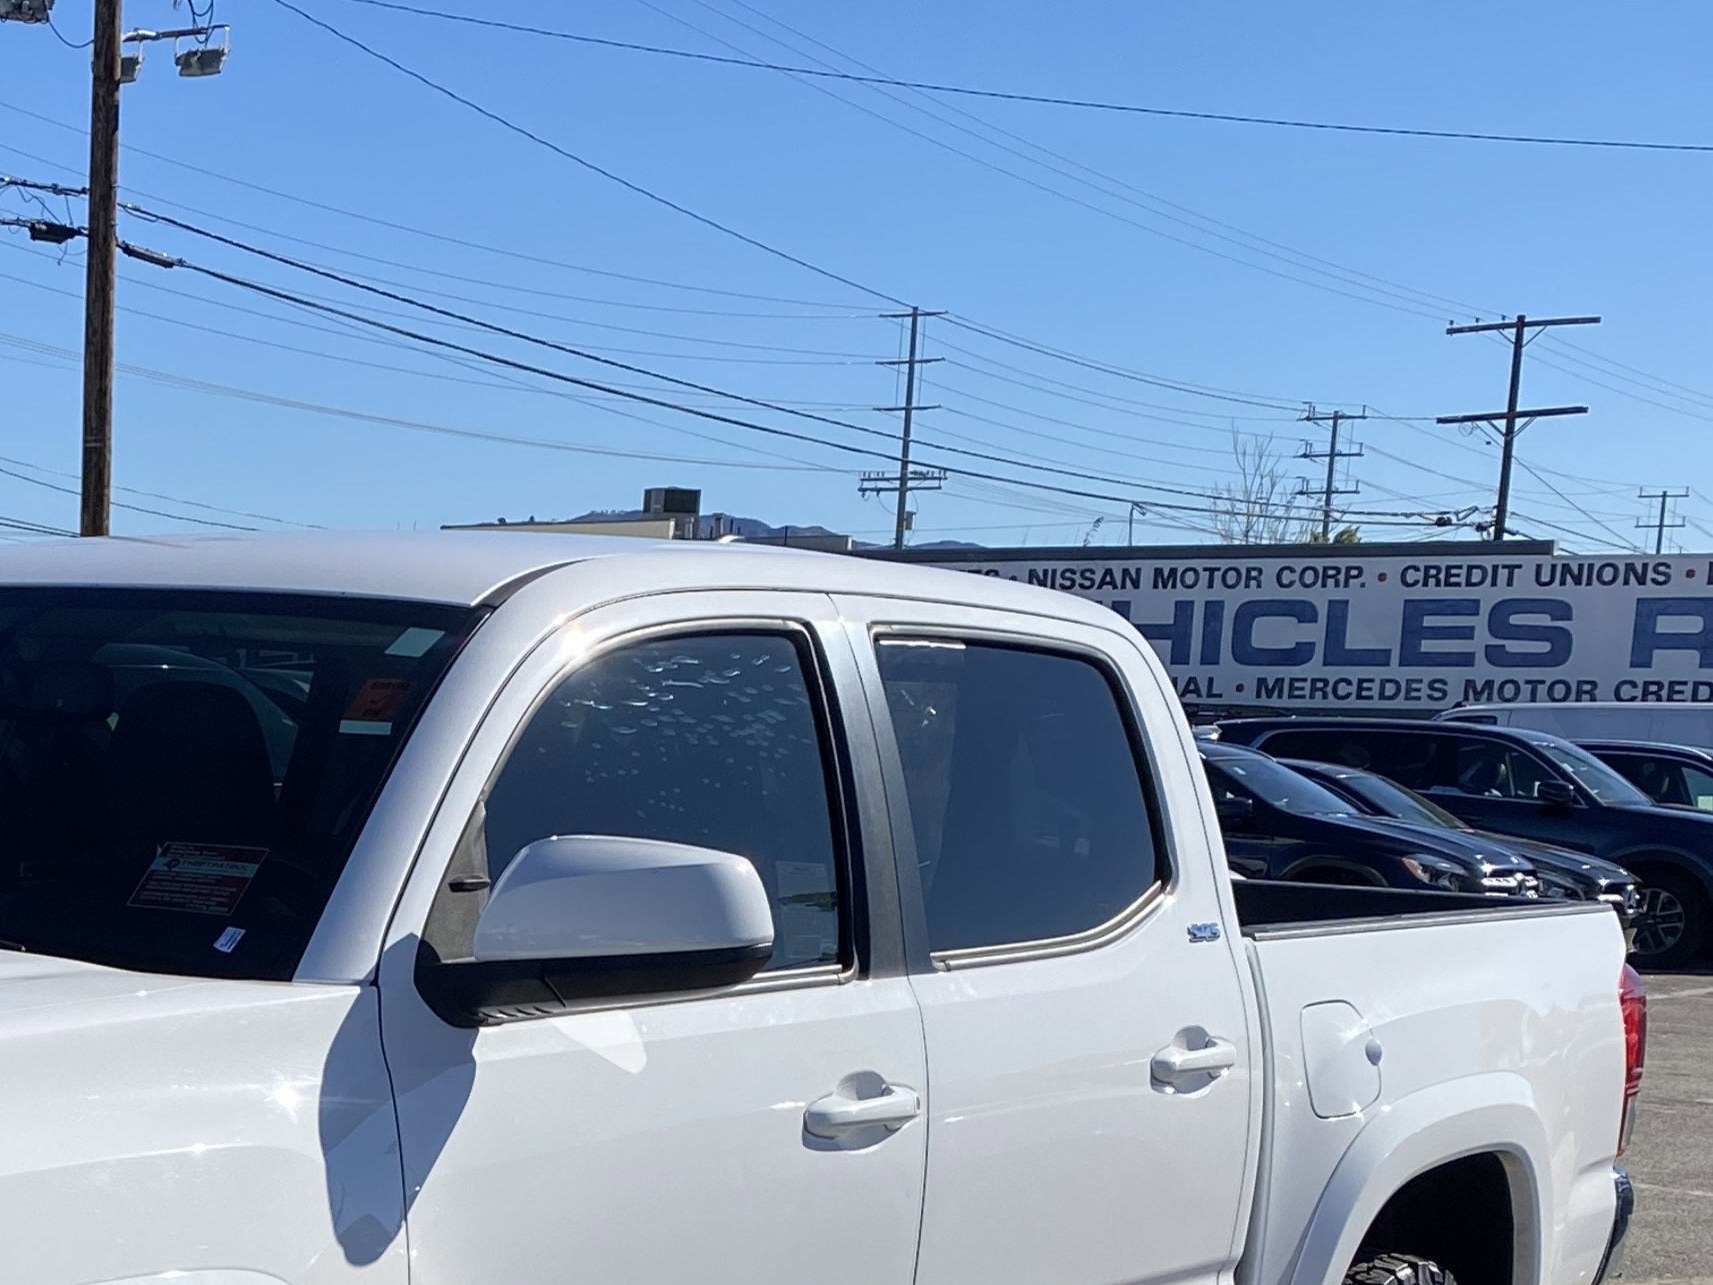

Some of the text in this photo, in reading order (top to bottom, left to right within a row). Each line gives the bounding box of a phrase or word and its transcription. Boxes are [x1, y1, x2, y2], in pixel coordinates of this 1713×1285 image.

[1027, 561, 1673, 591] NISSAN MOTOR CORP. CREDIT UNIONS
[1090, 597, 1574, 668] HICLES
[1254, 676, 1449, 702] MERCEDES
[1462, 678, 1598, 702] MOTOR
